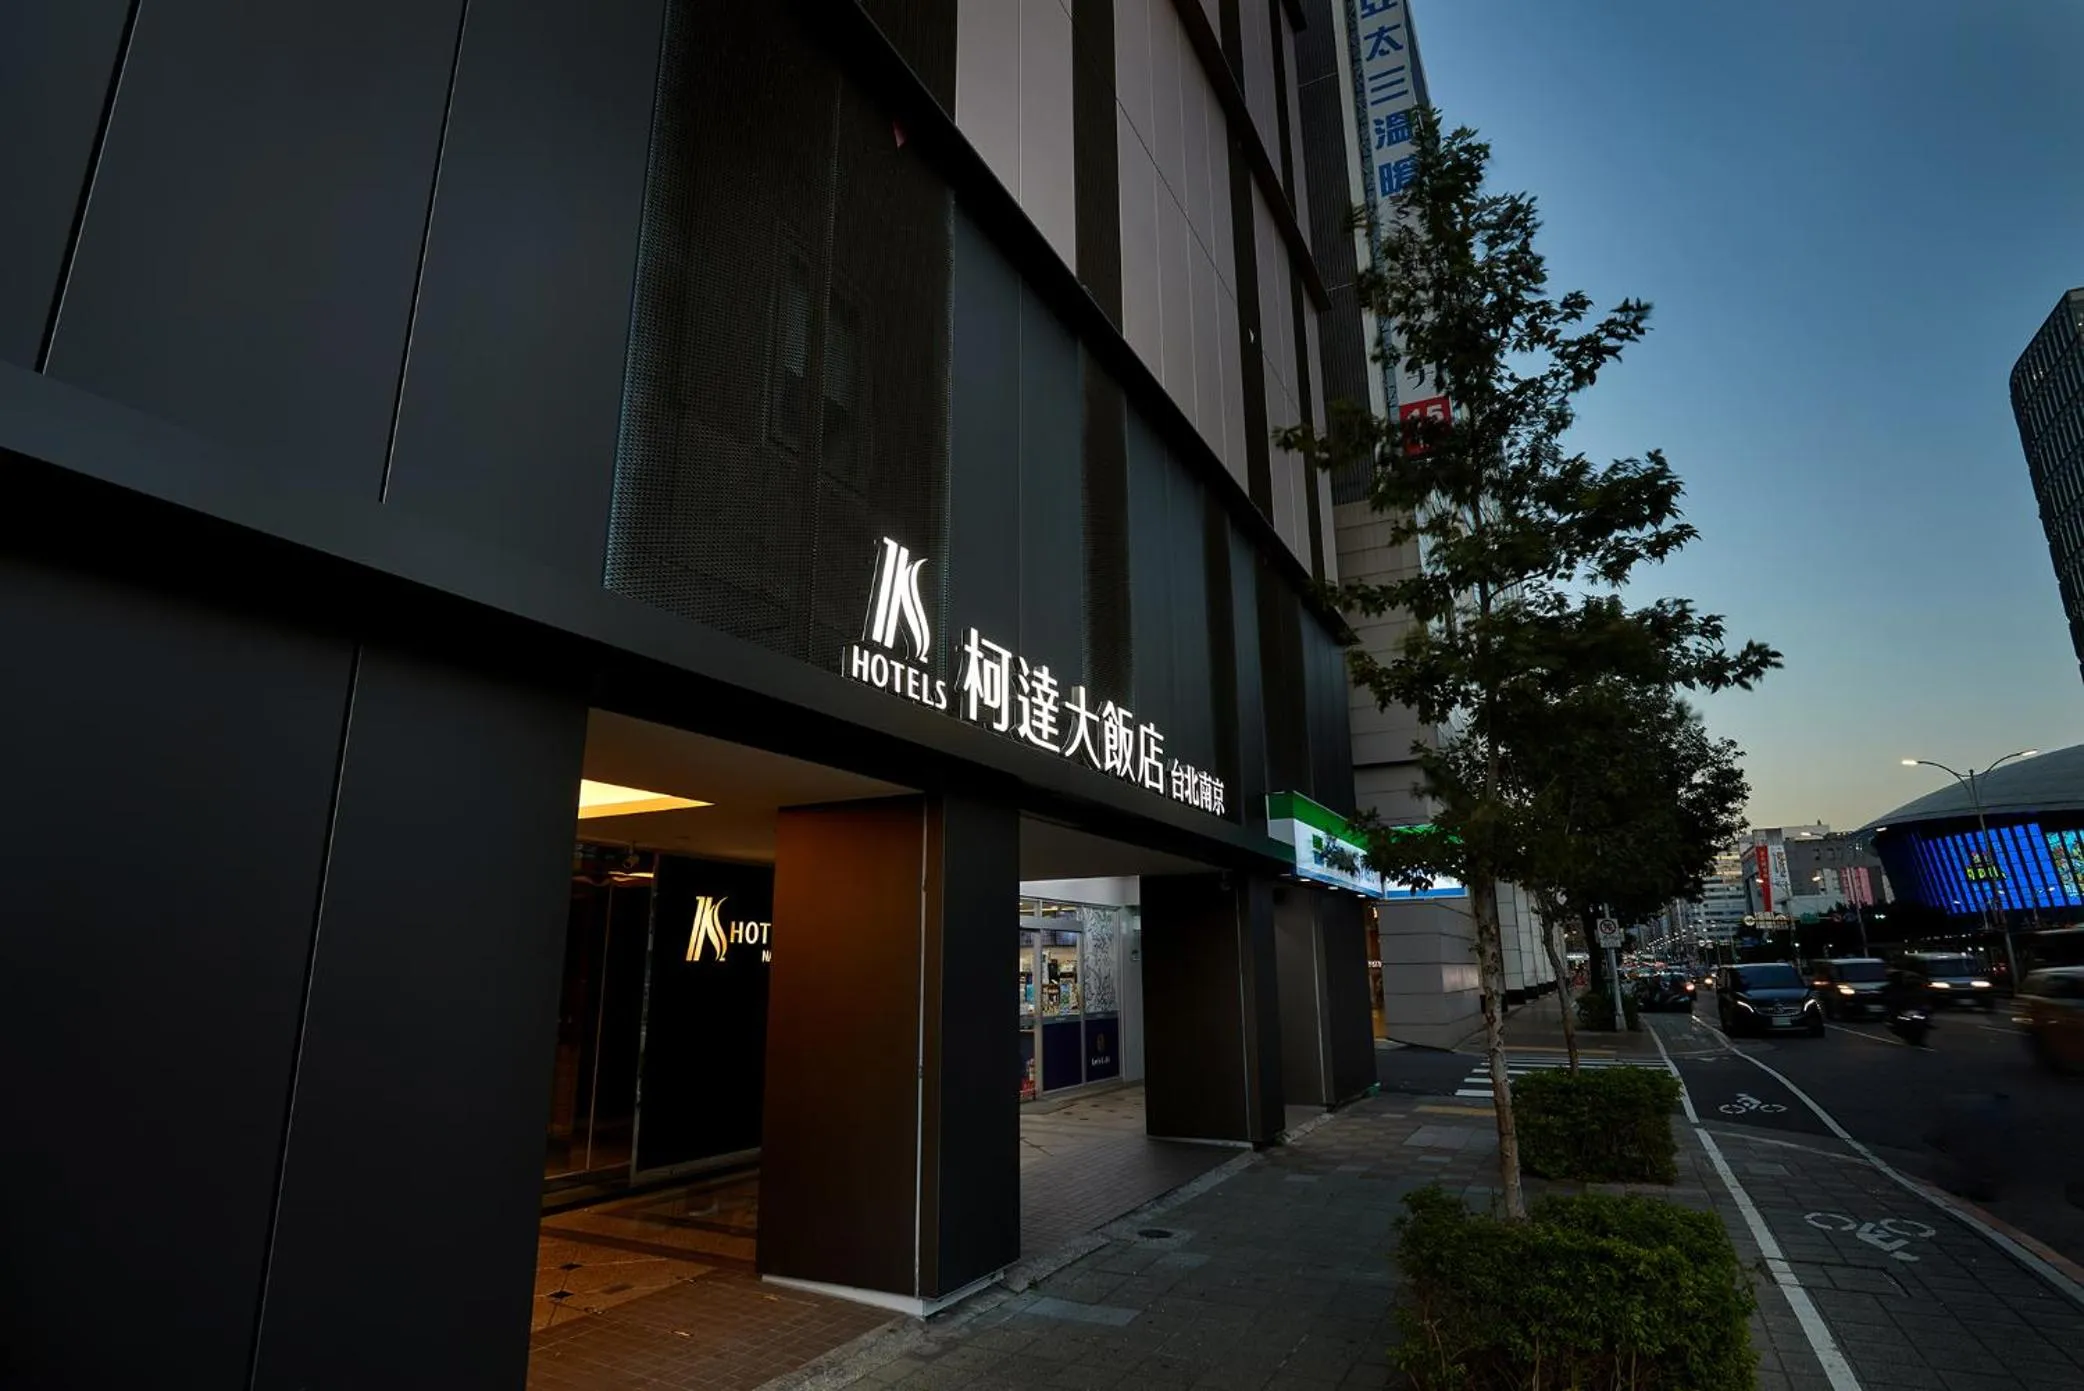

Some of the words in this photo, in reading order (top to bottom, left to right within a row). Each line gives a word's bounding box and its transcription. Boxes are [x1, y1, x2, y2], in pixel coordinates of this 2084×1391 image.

[852, 644, 948, 710] HOTELS
[963, 627, 1165, 795] 柯達大飯店
[1170, 757, 1226, 817] 台北南京
[729, 920, 772, 945] HOT
